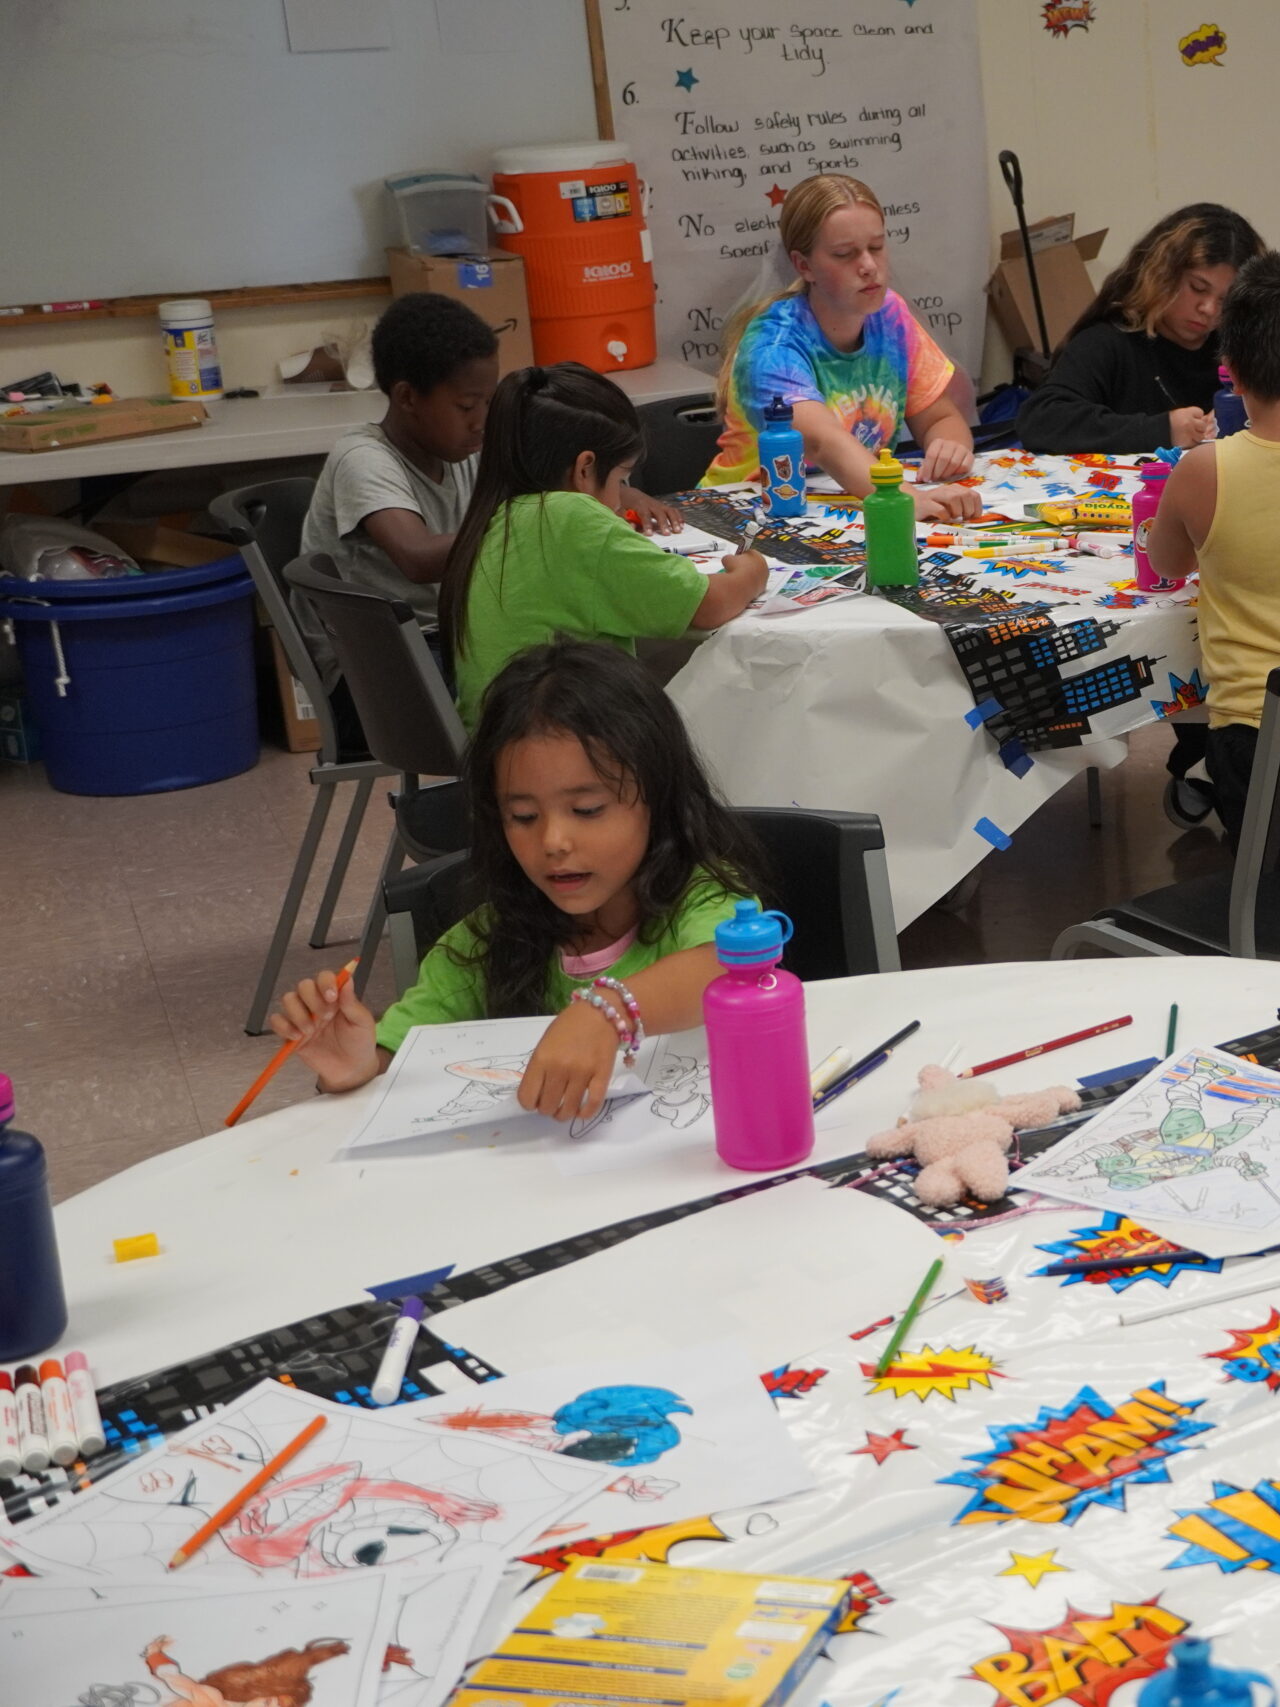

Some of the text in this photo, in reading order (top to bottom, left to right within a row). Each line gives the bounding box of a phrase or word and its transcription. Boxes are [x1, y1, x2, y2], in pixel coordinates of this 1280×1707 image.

[661, 17, 730, 49] Keep
[740, 26, 781, 54] your
[904, 23, 935, 35] and
[622, 81, 640, 105] 6.
[675, 103, 927, 137] Follow safety rules during all
[758, 160, 792, 176] and
[678, 212, 716, 239] No
[882, 202, 921, 217] nless
[1083, 503, 1132, 512] rayola
[957, 1387, 1195, 1525] WHAM!
